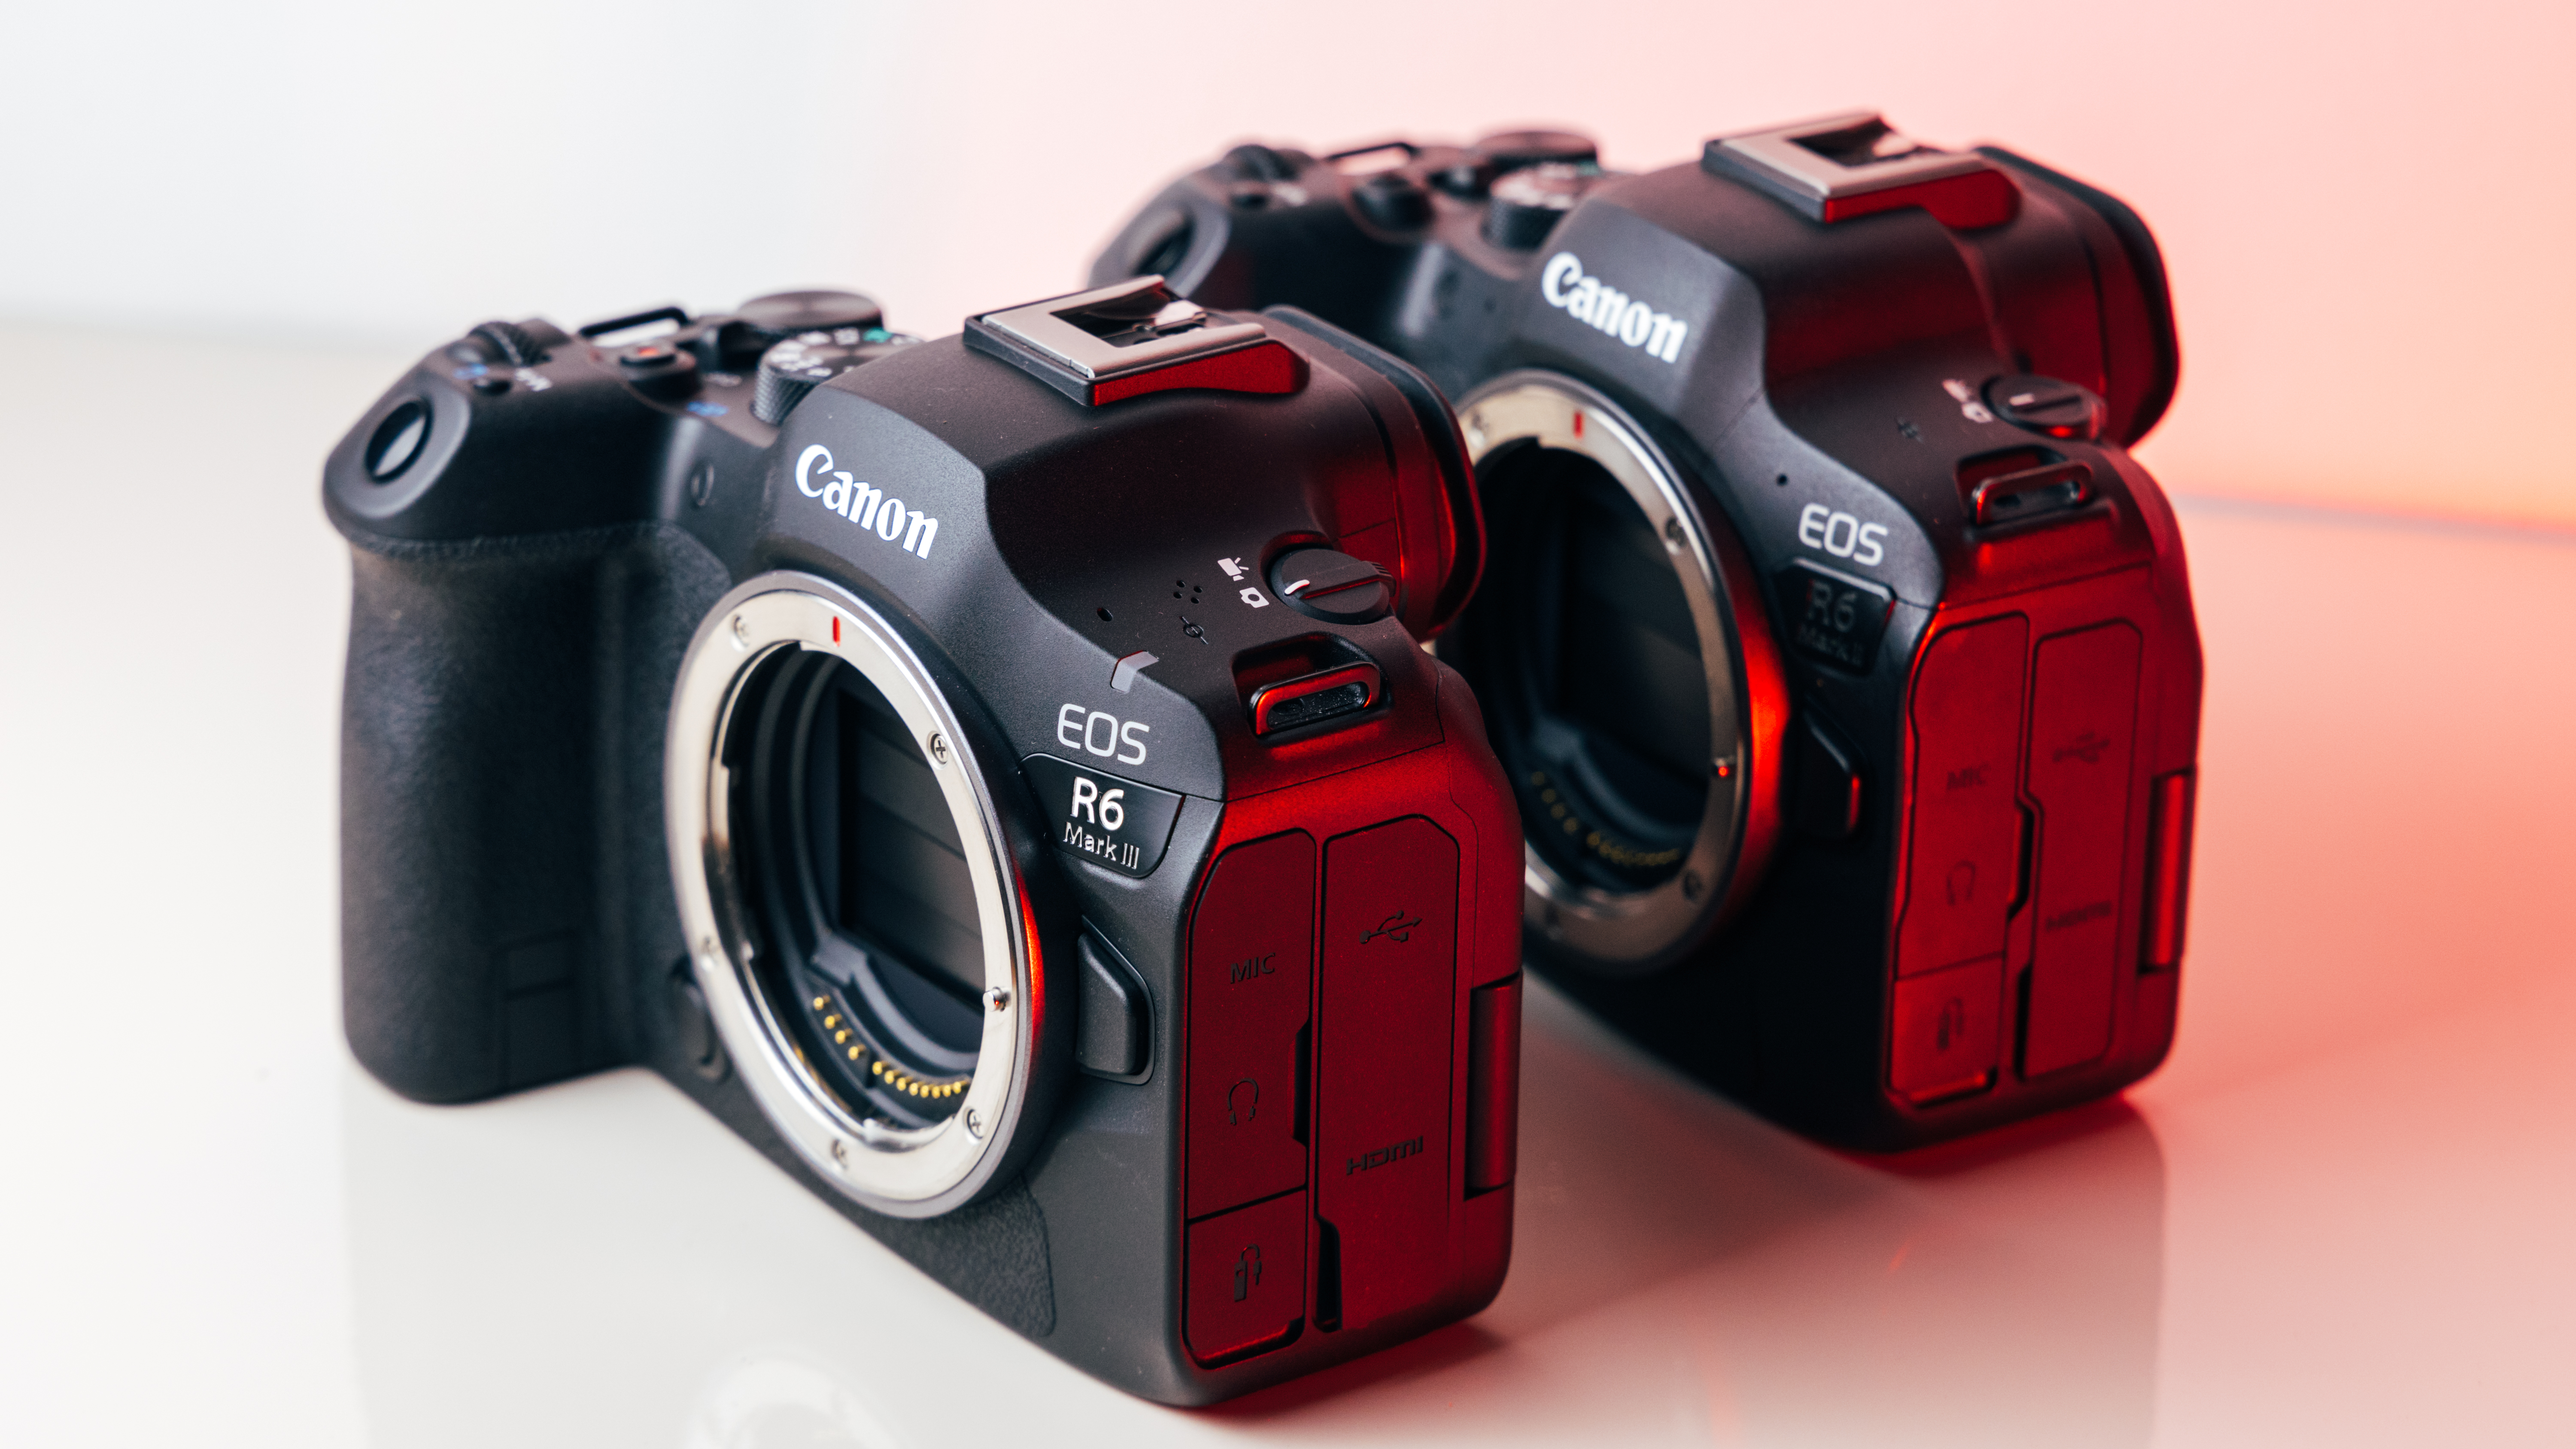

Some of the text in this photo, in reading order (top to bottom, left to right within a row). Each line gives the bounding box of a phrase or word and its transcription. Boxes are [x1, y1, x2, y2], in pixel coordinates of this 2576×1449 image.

[1542, 252, 1688, 364] Canon
[795, 444, 939, 559] Canon
[1798, 502, 1889, 567] EOS
[1807, 579, 1857, 633] R6
[1057, 703, 1150, 766] EOS
[1070, 776, 1124, 831] R6
[1063, 822, 1140, 869] Mark III
[1230, 952, 1276, 985] MIC
[1346, 1136, 1423, 1176] HDMI
